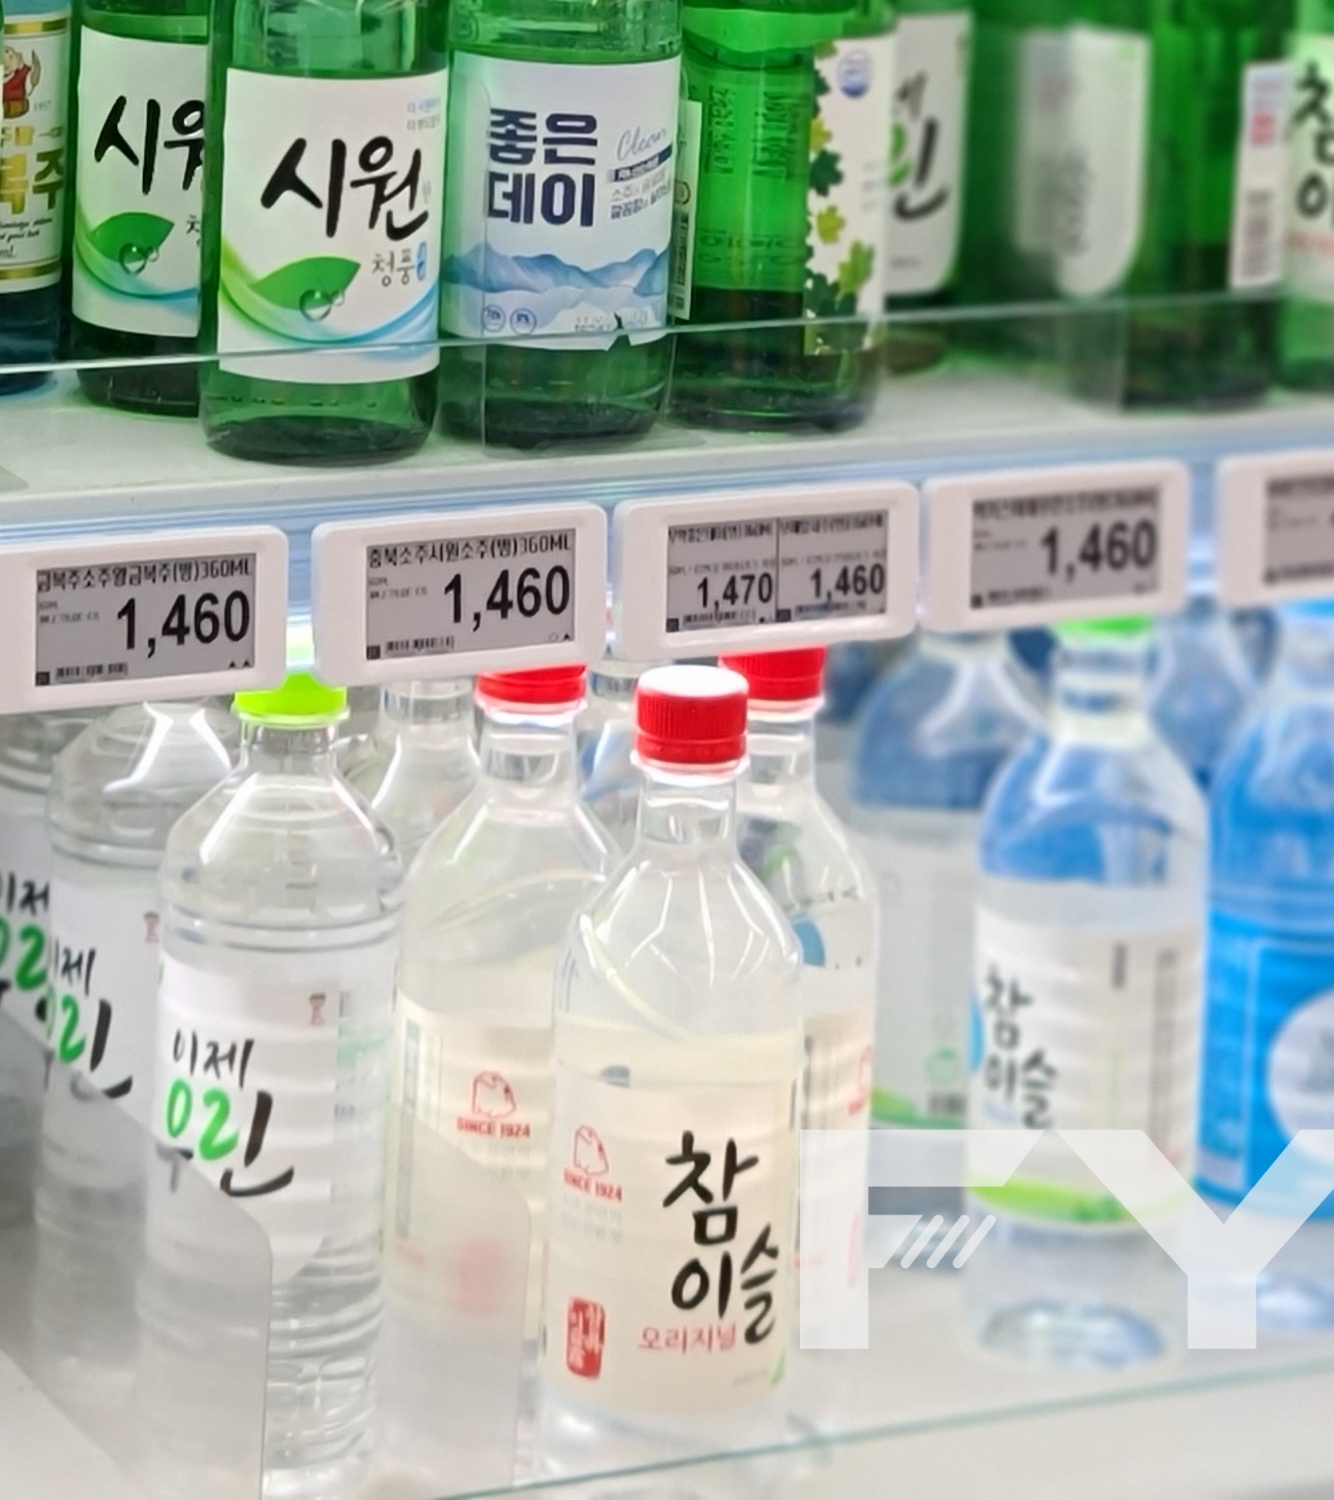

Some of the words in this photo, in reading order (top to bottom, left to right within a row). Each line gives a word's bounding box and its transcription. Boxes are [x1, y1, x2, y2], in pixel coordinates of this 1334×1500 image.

[489, 107, 599, 167] 좋은
[259, 135, 431, 241] 시원
[486, 170, 597, 228] 데이
[1039, 519, 1159, 582] 1,460
[442, 564, 571, 632] 1,460
[696, 572, 774, 613] 1,470
[810, 563, 886, 607] 1,460
[115, 588, 252, 659] 1,460
[456, 1117, 496, 1136] SINCE
[499, 1121, 531, 1139] 1924
[594, 1179, 623, 1202] 1924
[662, 1129, 781, 1346] 참이슬
[637, 1321, 737, 1354] 오리지널
